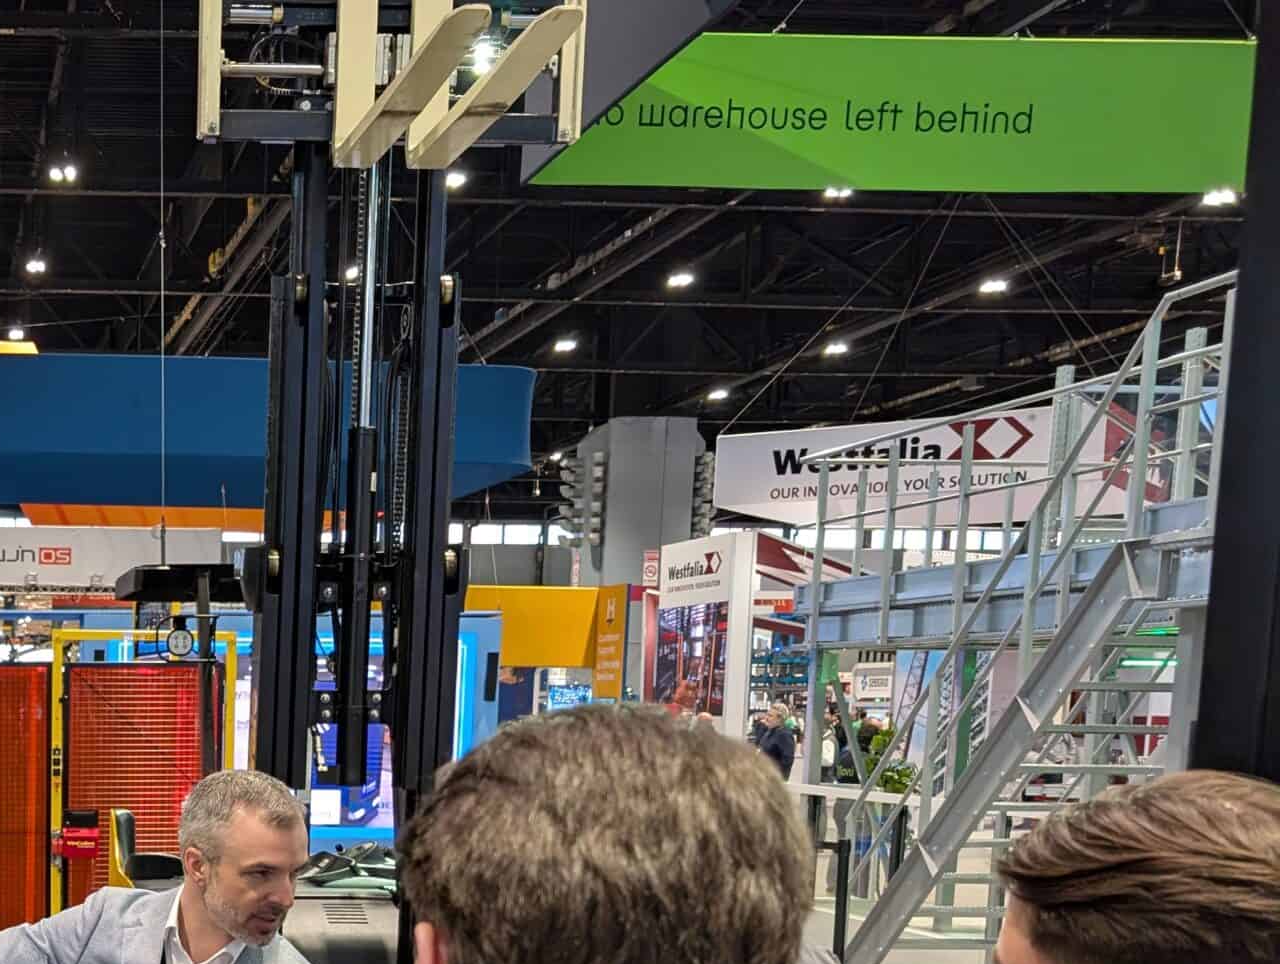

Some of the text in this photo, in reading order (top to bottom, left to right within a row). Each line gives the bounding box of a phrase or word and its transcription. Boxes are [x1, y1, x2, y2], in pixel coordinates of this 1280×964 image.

[594, 99, 1033, 136] o warehouse left behind
[771, 487, 800, 500] OUR
[949, 470, 1028, 489] SLUTION
[668, 561, 704, 581] Westfalia
